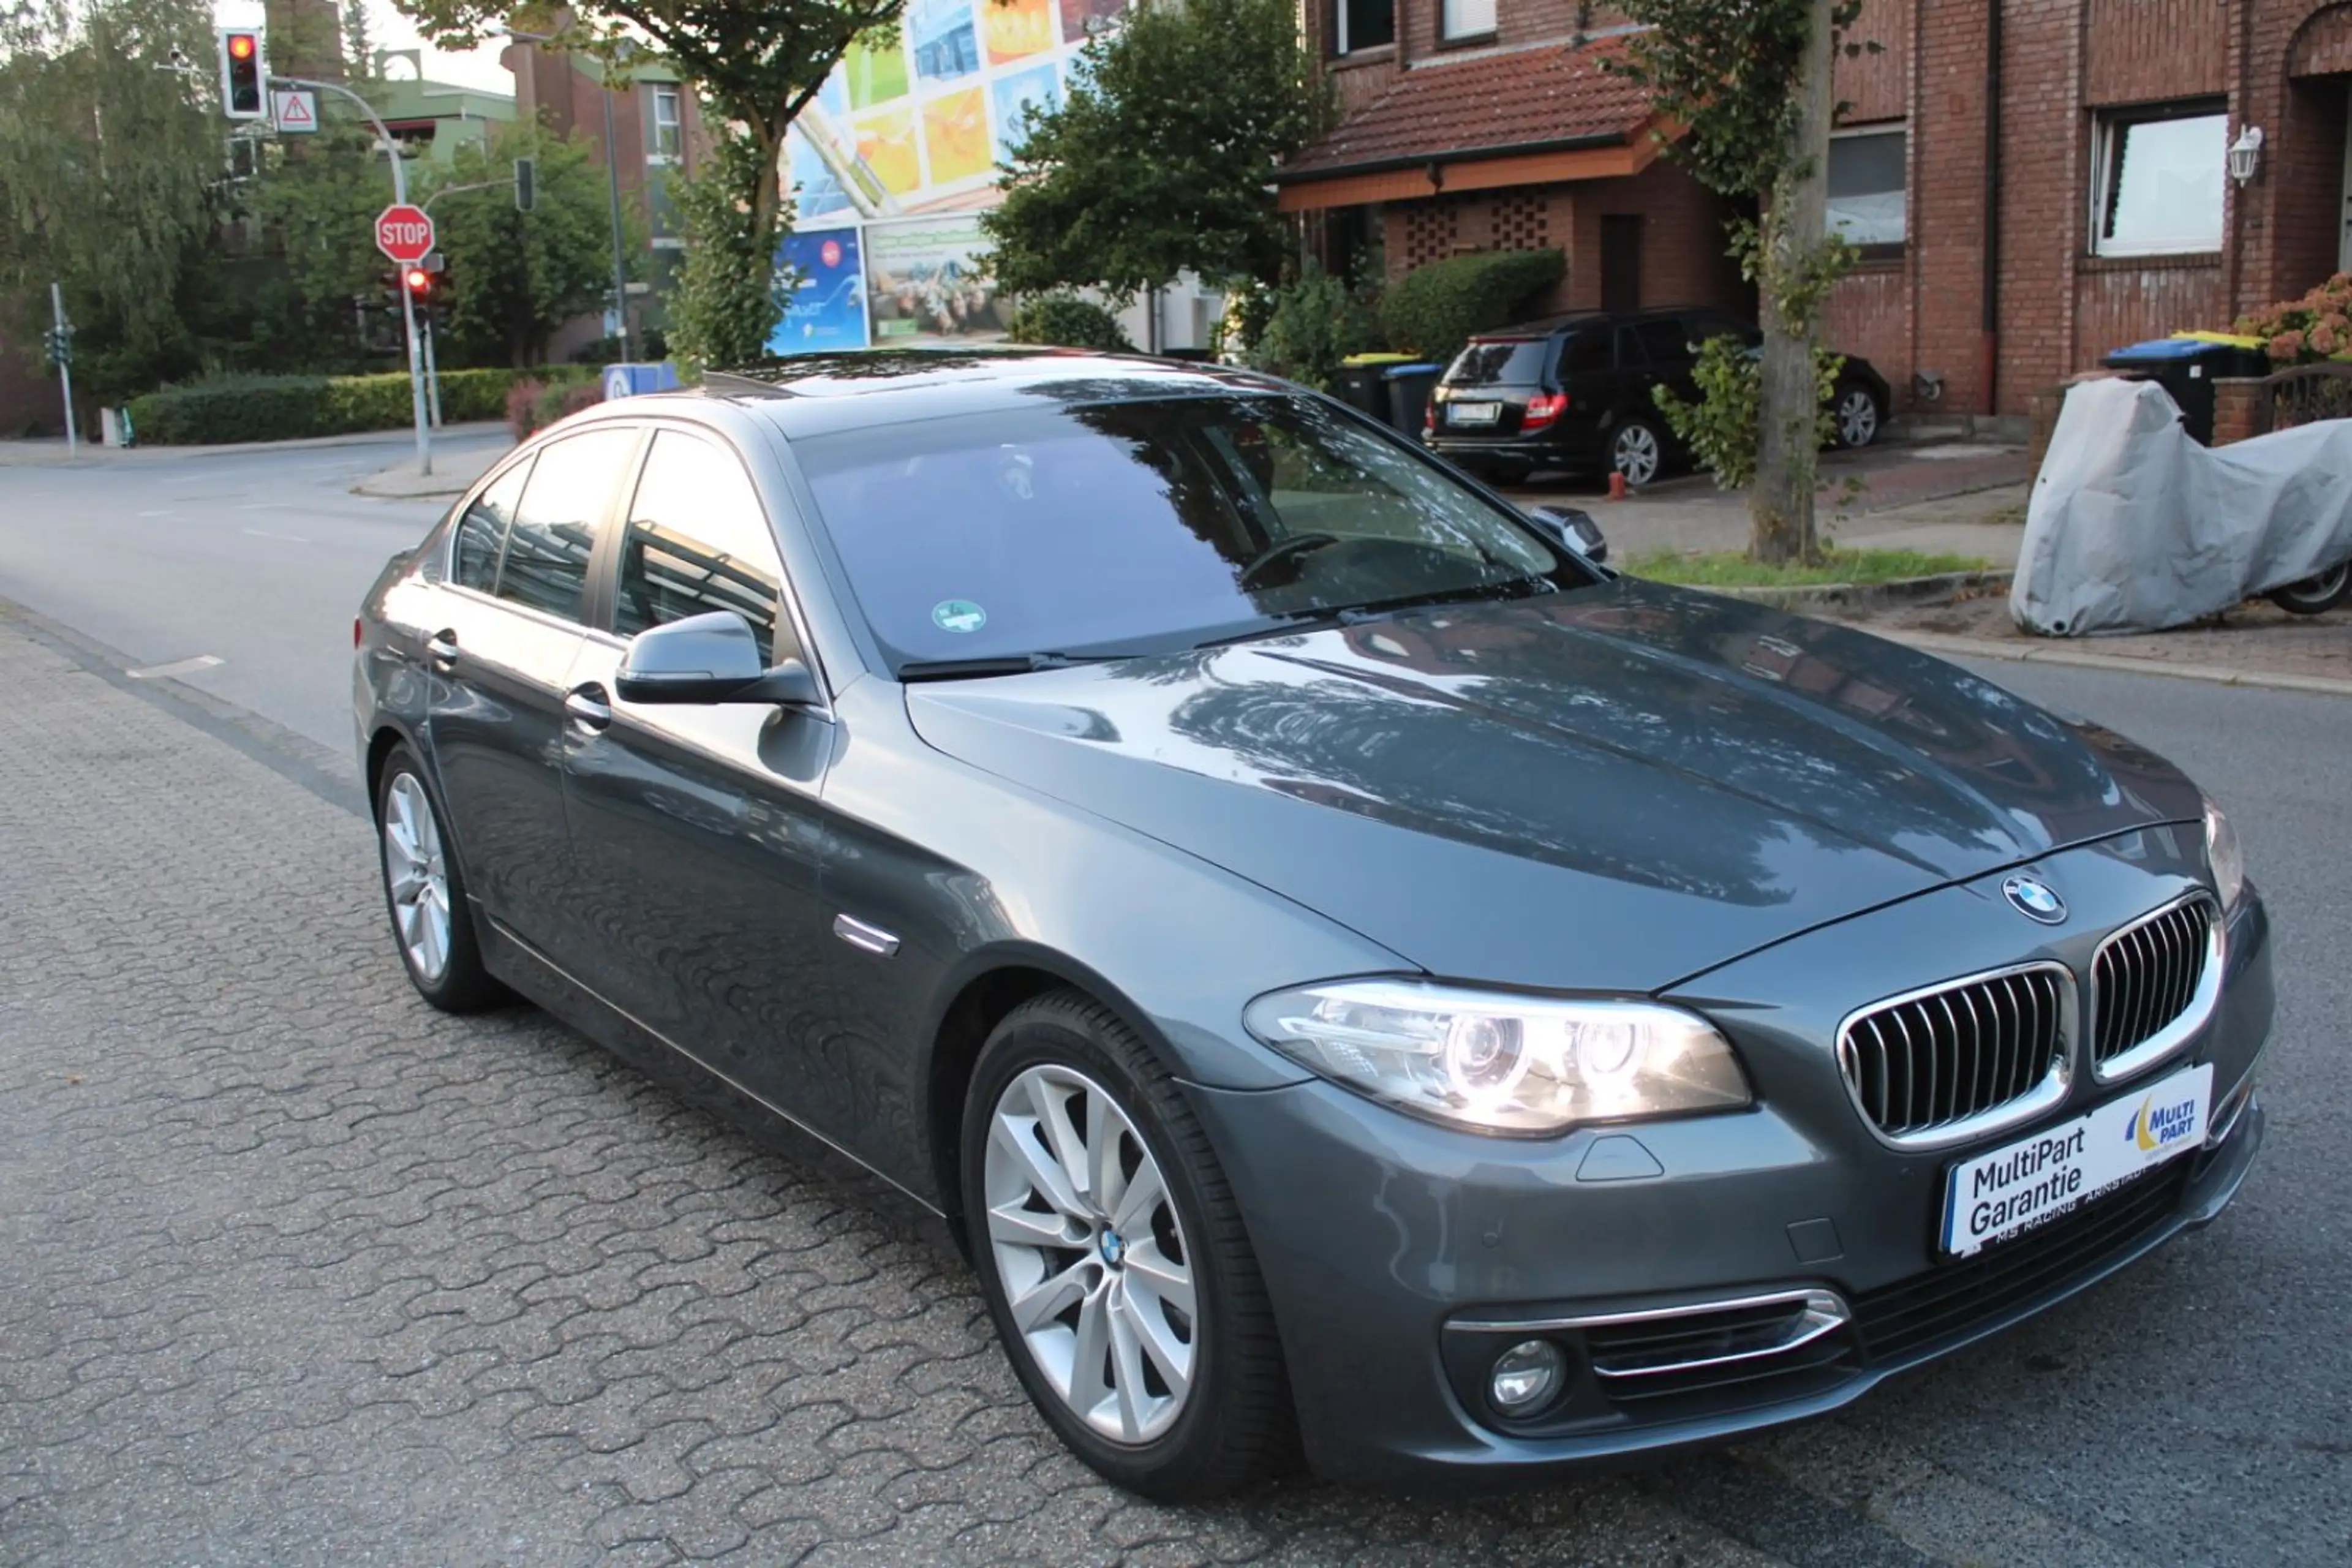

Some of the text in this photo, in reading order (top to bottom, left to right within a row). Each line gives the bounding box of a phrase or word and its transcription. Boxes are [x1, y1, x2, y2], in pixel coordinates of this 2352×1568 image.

[382, 222, 428, 245] STOP
[2149, 1099, 2195, 1133] MULTI
[2160, 1116, 2195, 1144] PART
[1973, 1126, 2085, 1199] MultiPart
[1970, 1165, 2081, 1235] Garantie
[2024, 1201, 2076, 1233] RACING
